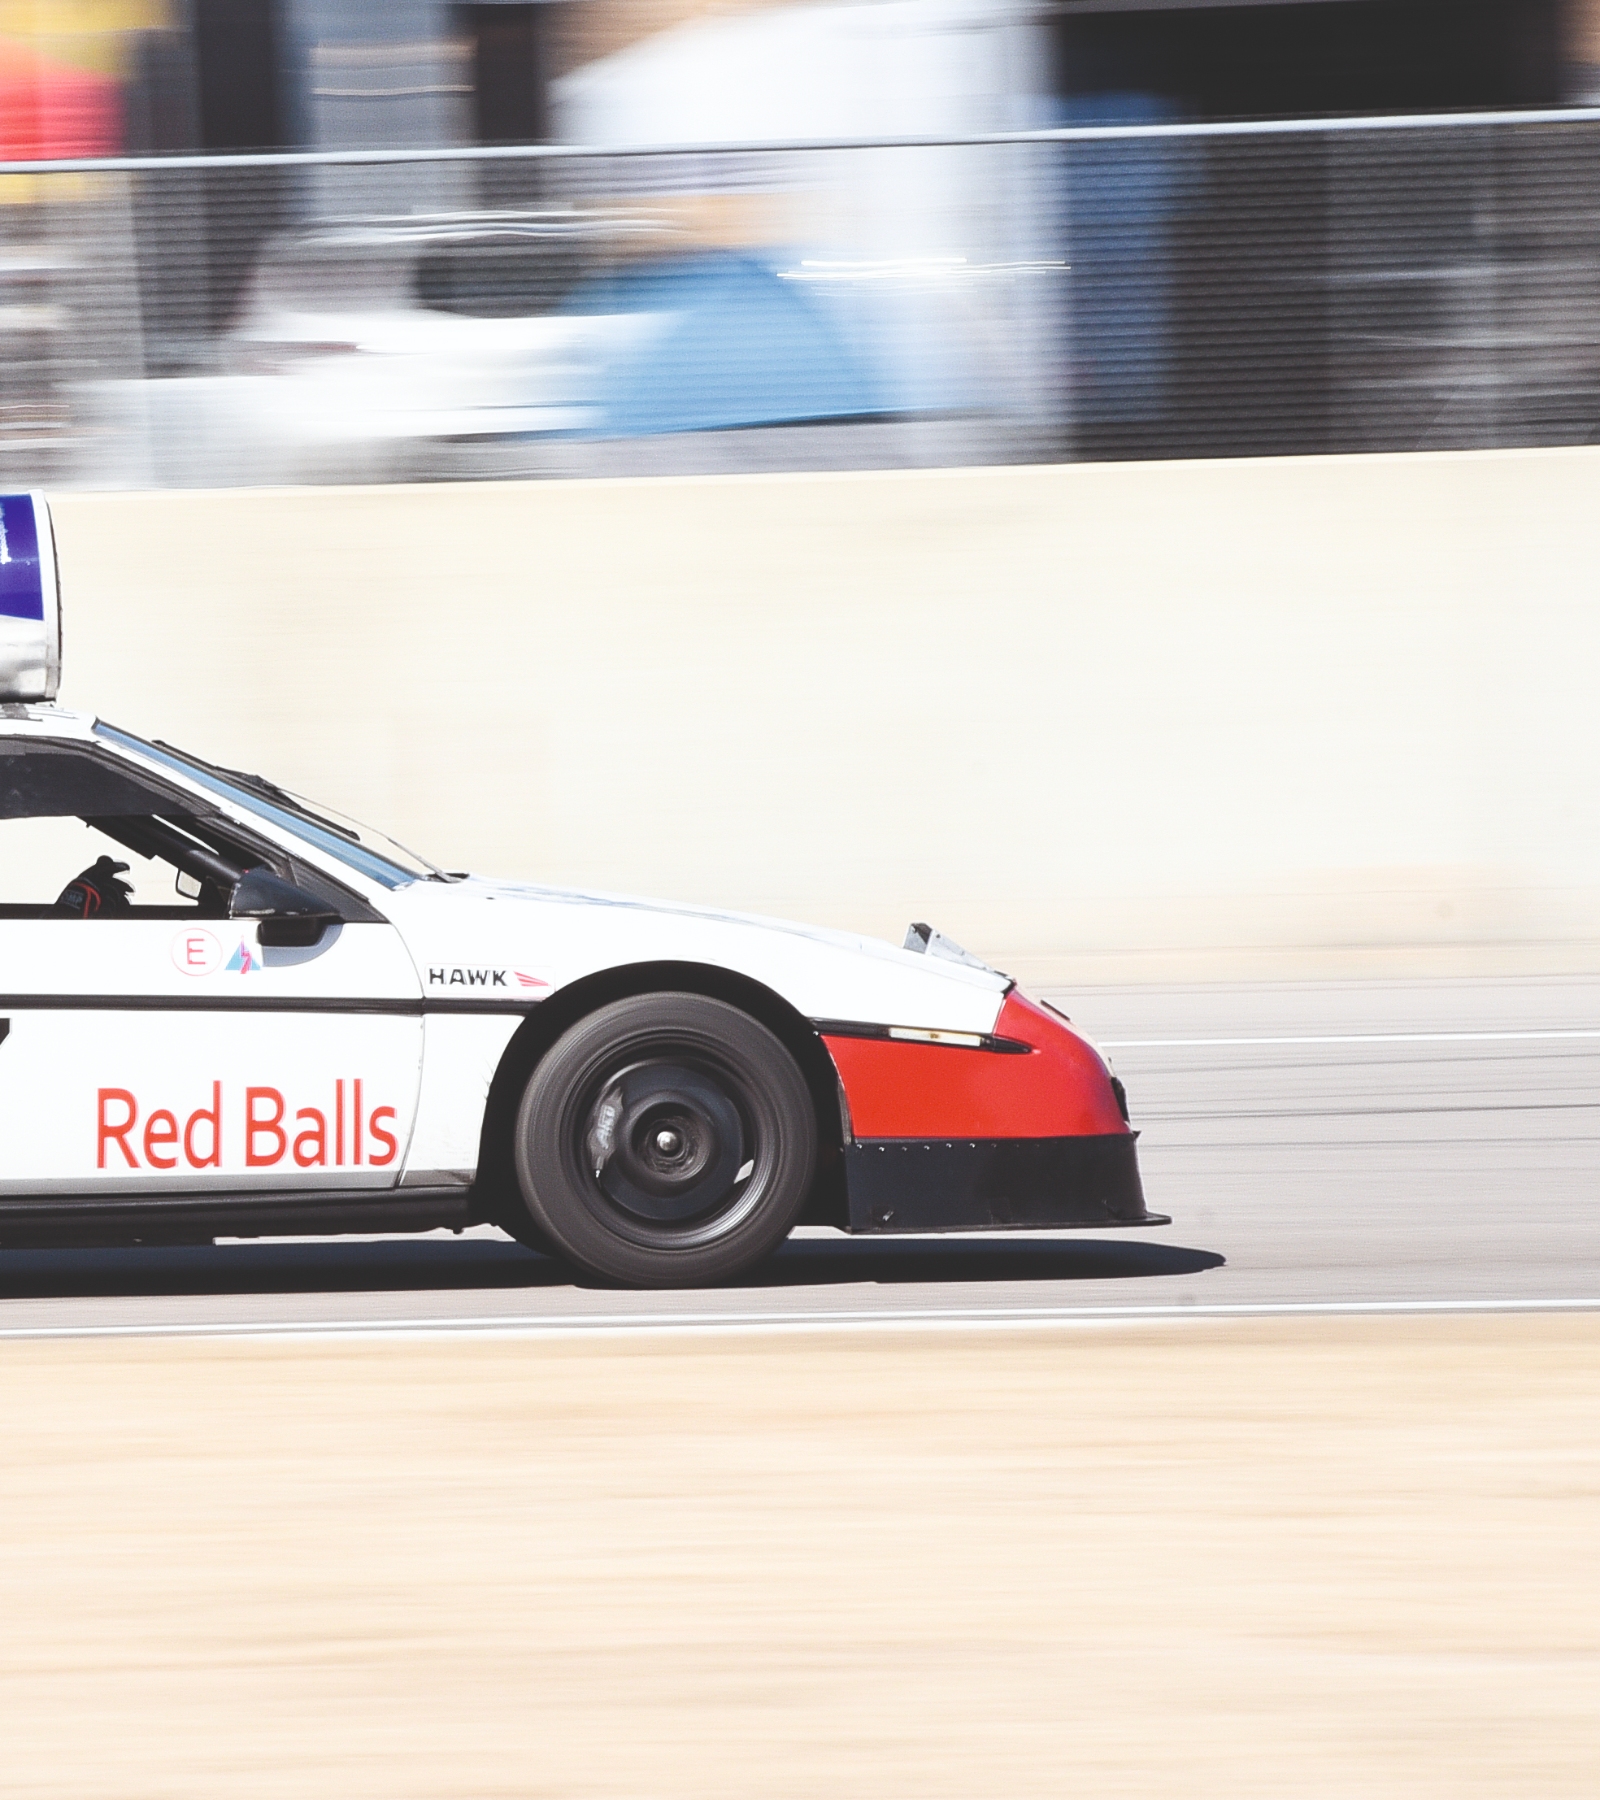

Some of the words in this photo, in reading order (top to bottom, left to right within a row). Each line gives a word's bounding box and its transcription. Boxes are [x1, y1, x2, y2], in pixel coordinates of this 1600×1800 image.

[186, 938, 206, 965] E
[429, 968, 508, 986] HAWK
[97, 1080, 223, 1169] Red
[245, 1078, 398, 1167] Balls
